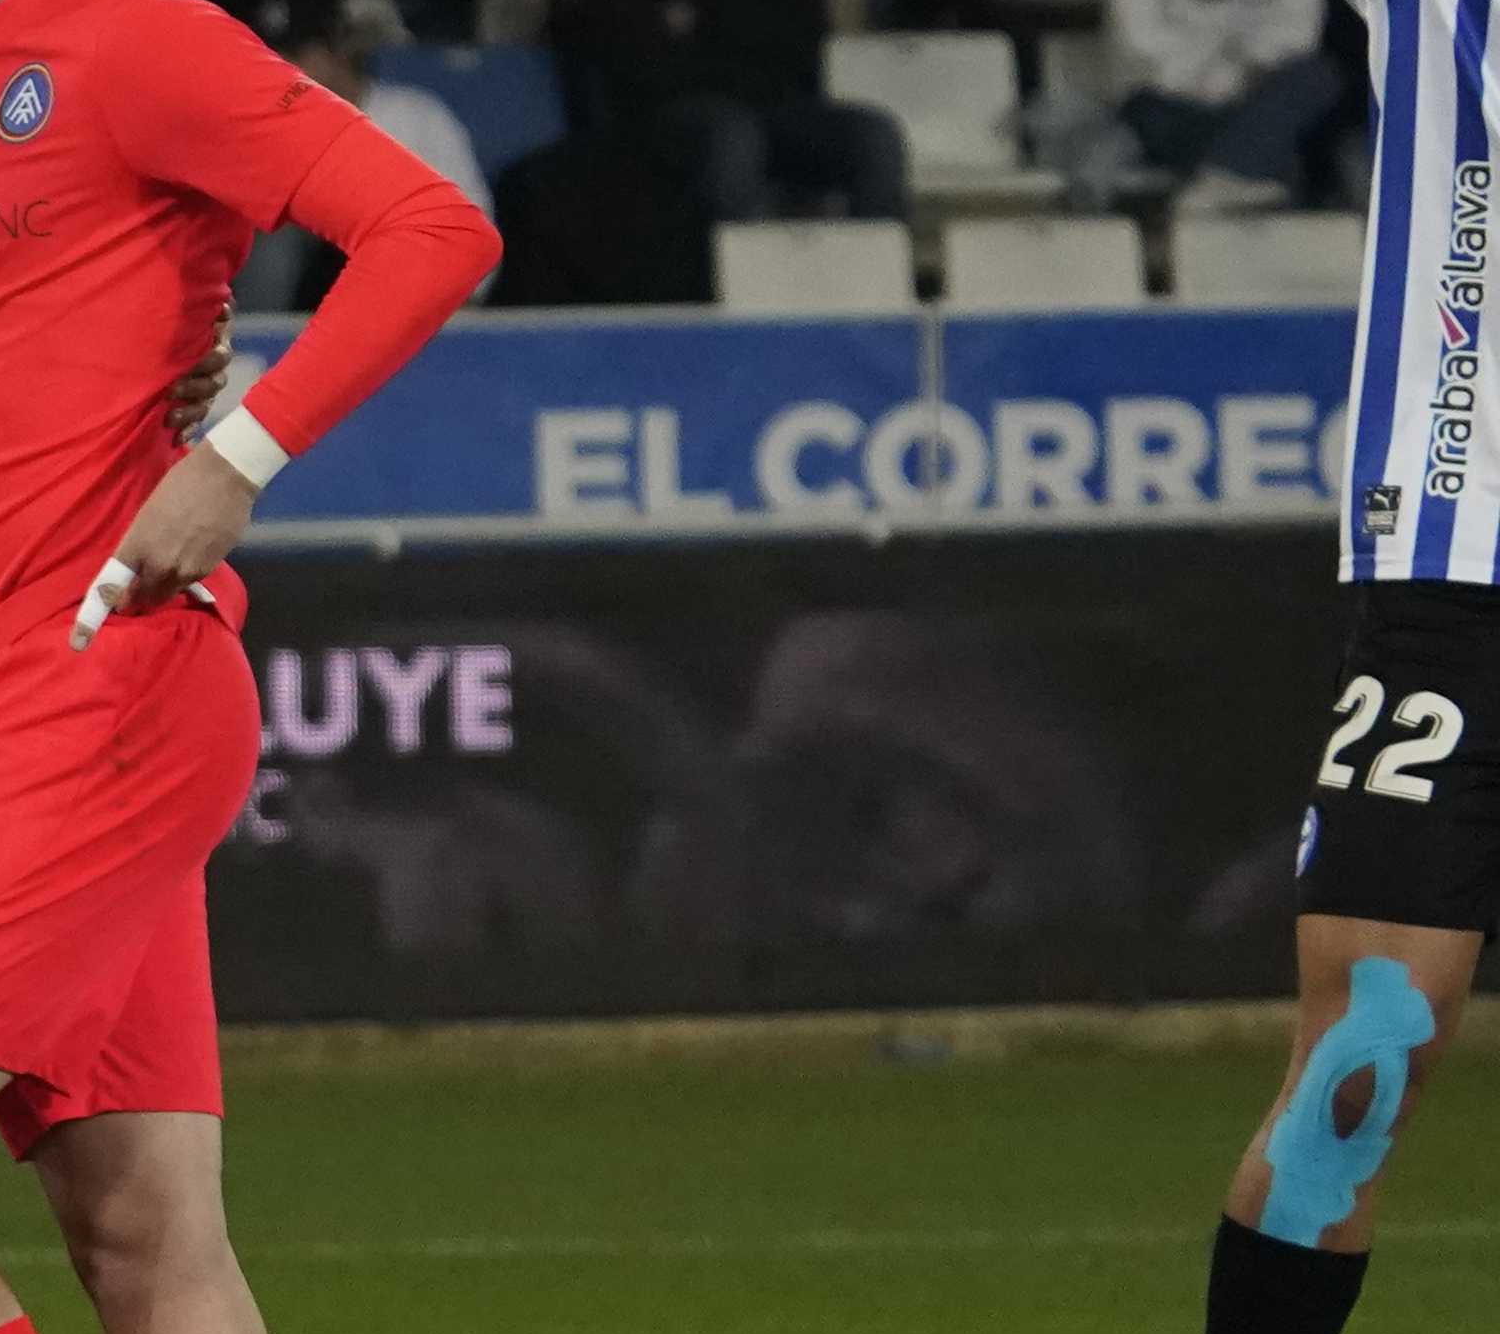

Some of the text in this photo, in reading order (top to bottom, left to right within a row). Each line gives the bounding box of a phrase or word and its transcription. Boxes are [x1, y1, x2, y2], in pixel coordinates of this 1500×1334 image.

[1427, 161, 1492, 499] araba álava
[533, 405, 734, 518] EL
[260, 644, 513, 754] UYE
[1316, 674, 1465, 804] 22
